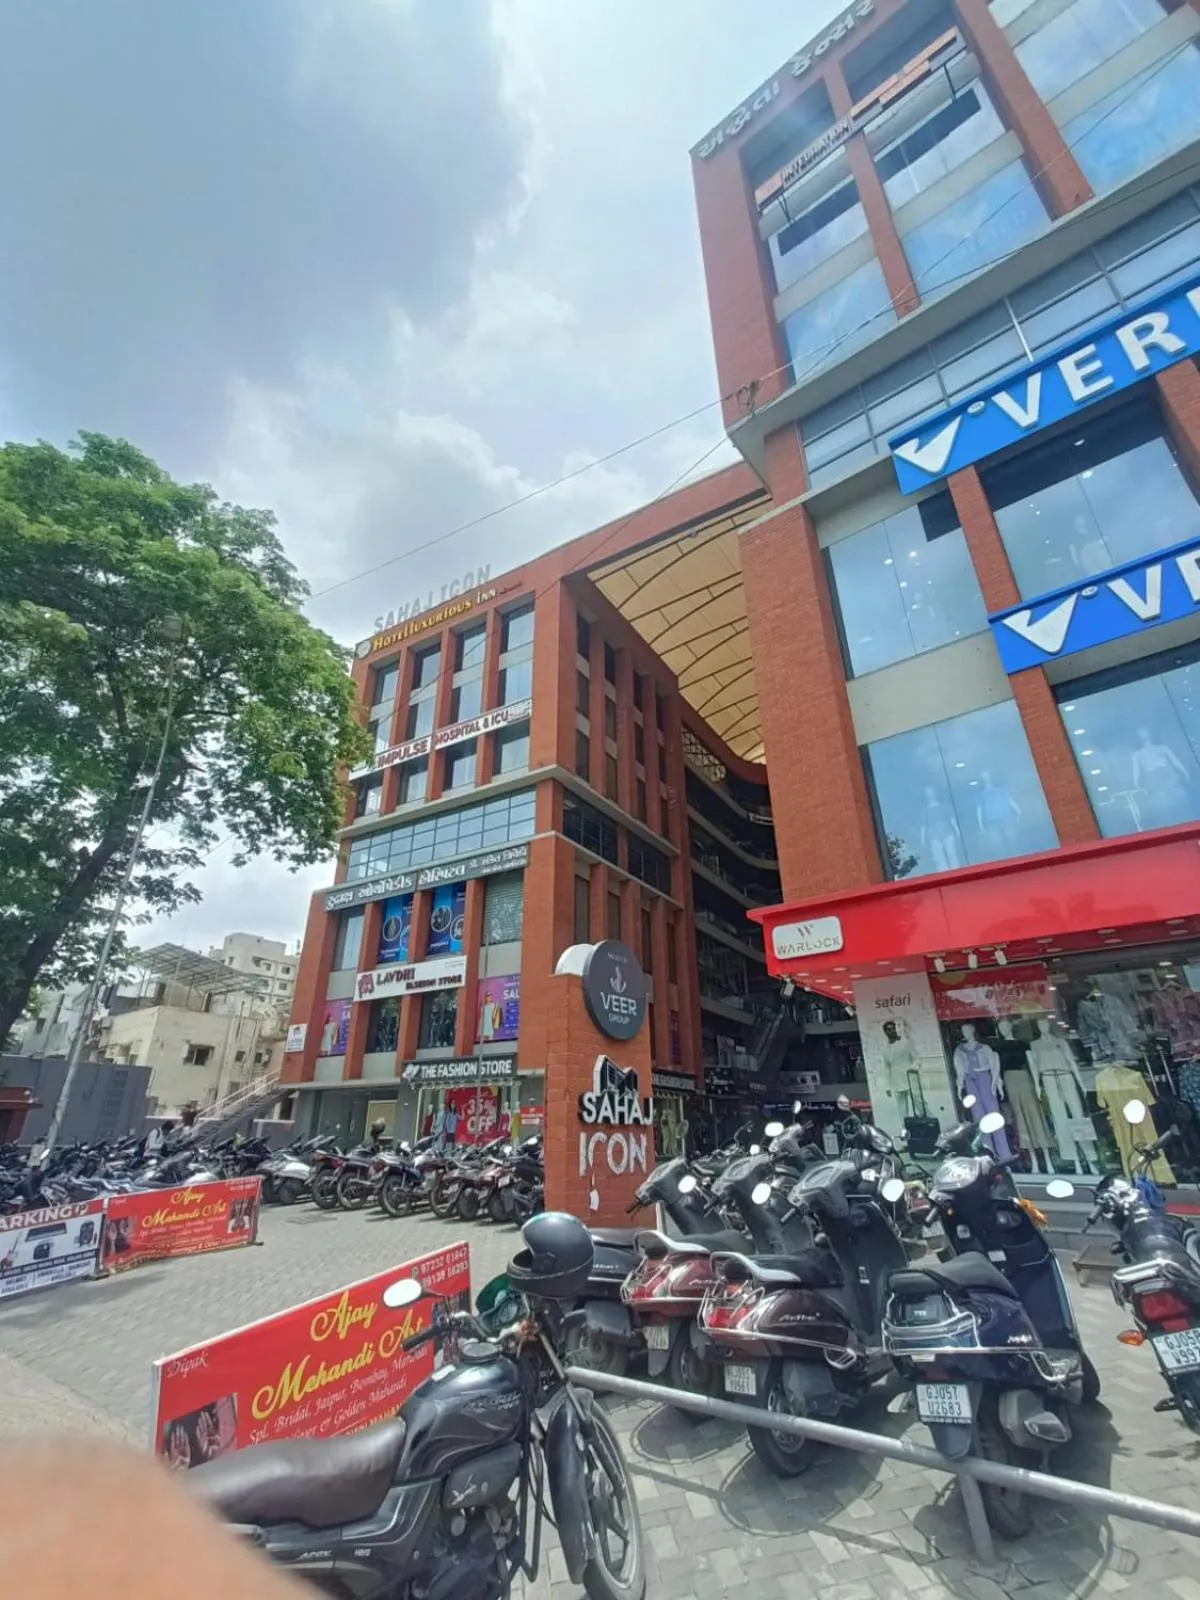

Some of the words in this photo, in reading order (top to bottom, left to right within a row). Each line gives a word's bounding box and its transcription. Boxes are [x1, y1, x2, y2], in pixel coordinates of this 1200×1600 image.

[374, 589, 433, 632] SAHAJ
[440, 564, 491, 603] ICON
[378, 739, 429, 767] IMPULSE
[434, 719, 481, 747] HOSPITAL
[491, 710, 509, 726] ICU
[776, 935, 841, 955] WARLOCK
[438, 974, 463, 986] STORE
[600, 991, 638, 1017] VEER
[874, 992, 911, 1009] safari
[421, 1064, 437, 1079] THE
[437, 1062, 477, 1078] FASHION
[480, 1059, 512, 1075] STORE
[581, 1089, 653, 1126] SAHAJ
[579, 1131, 648, 1177] ICON
[310, 1289, 378, 1342] Ajay
[167, 1347, 209, 1378] Dipak
[251, 1343, 375, 1420] Mehandi
[333, 1398, 366, 1429] Golden
